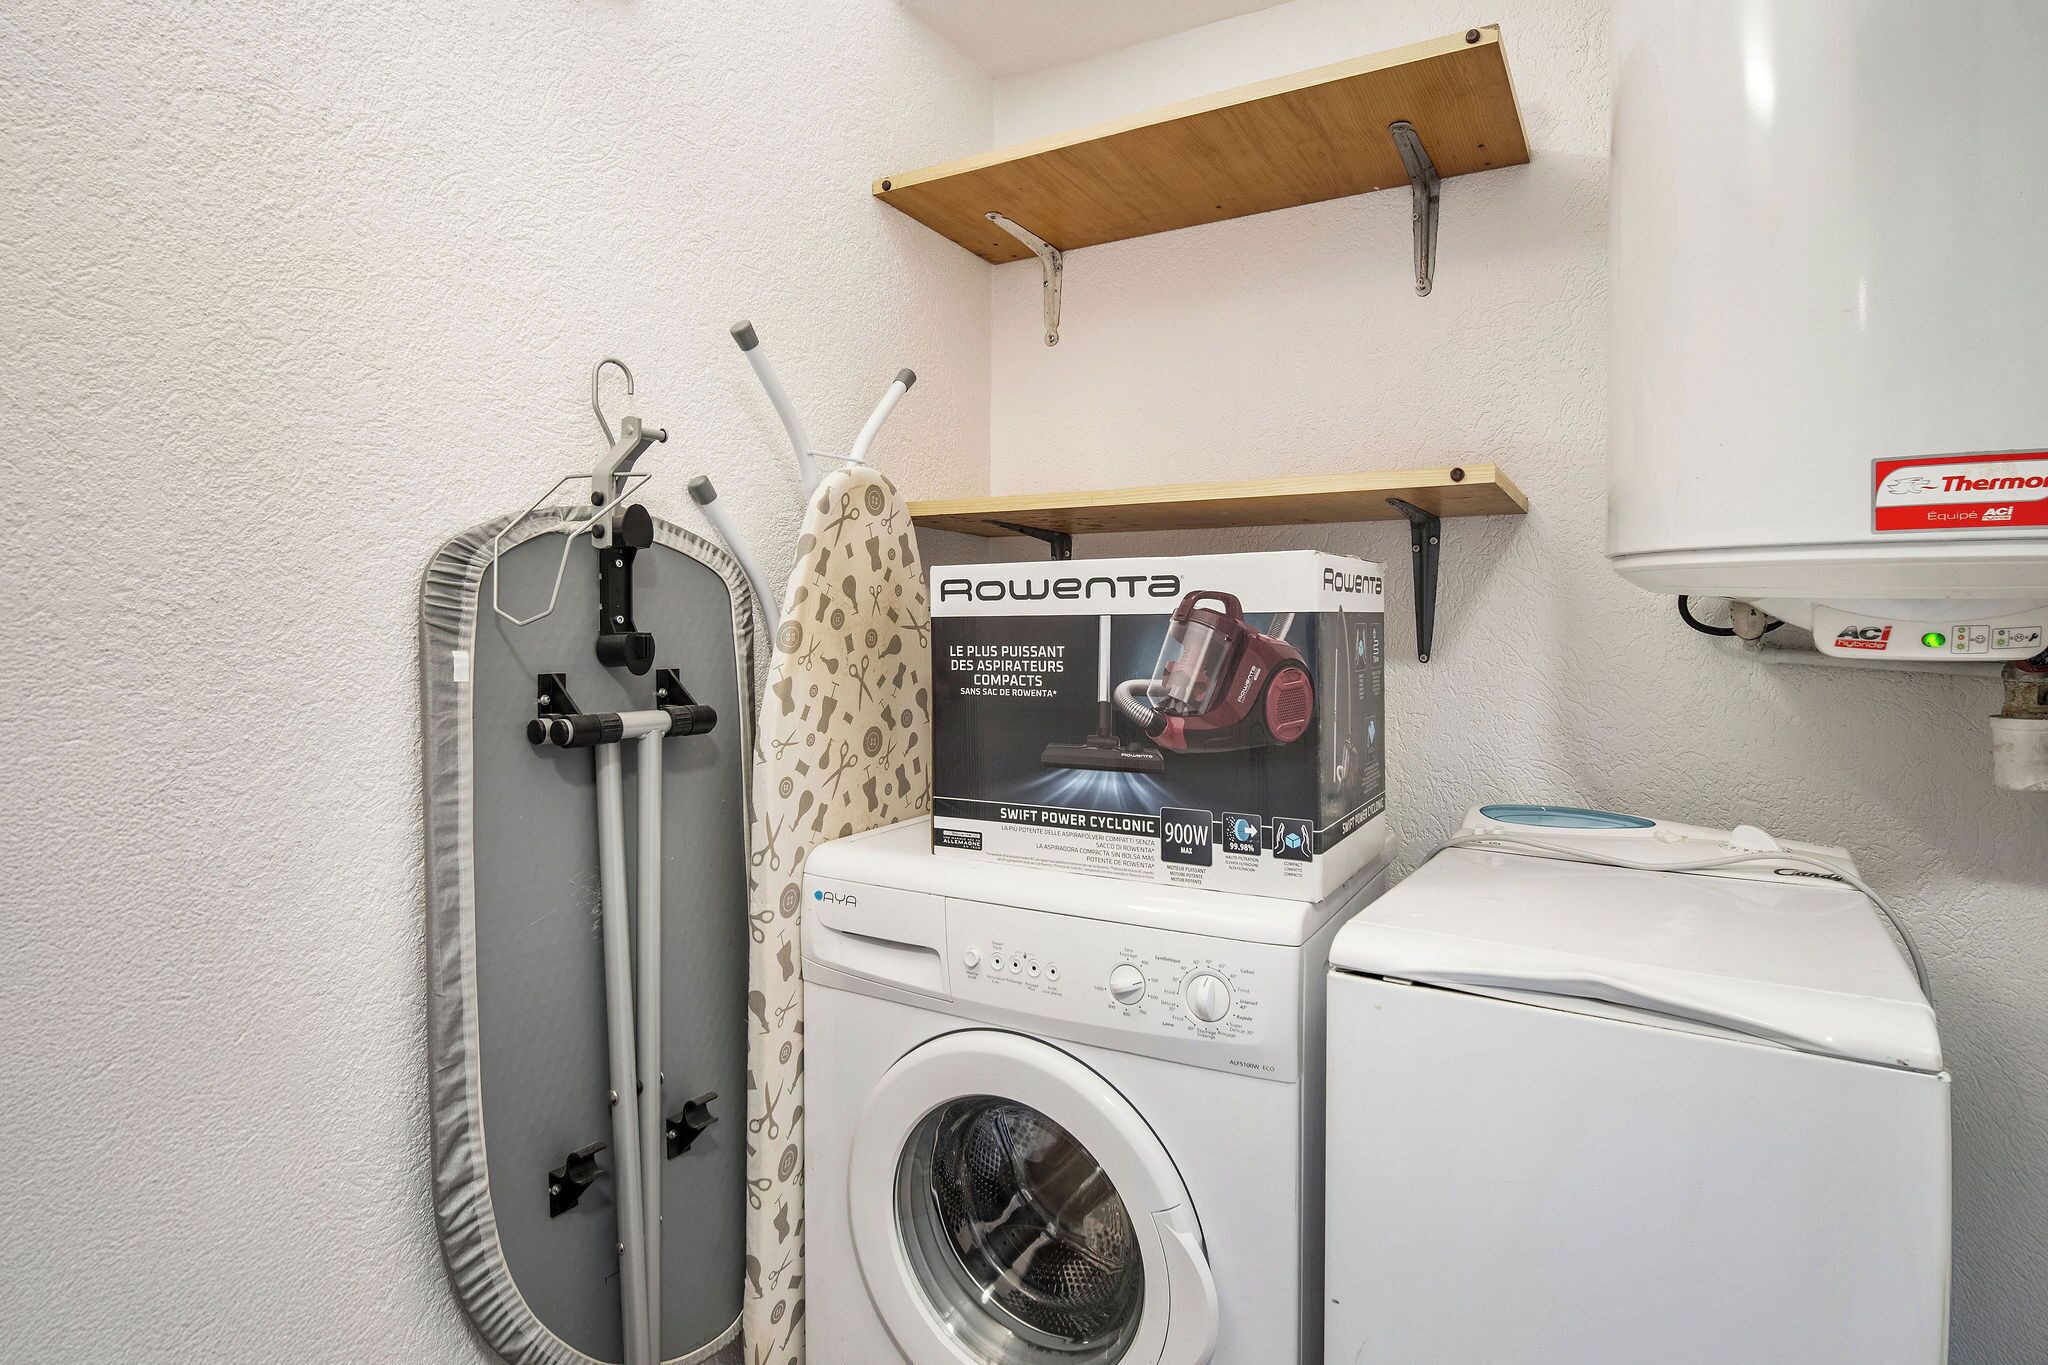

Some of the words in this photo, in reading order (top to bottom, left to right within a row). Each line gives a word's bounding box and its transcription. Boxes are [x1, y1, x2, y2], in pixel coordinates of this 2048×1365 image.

[1927, 510, 1978, 521] Équipé
[1837, 639, 1885, 649] hybride
[950, 645, 964, 657] LE
[967, 645, 998, 658] PLUS
[1001, 645, 1065, 658] PUISSANT
[951, 660, 974, 671] DES
[976, 660, 1064, 673] ASPIRATEURS
[973, 674, 1043, 687] COMPACTS
[960, 687, 981, 696] SANS
[982, 688, 998, 697] SAC
[999, 688, 1011, 697] DE
[1000, 807, 1038, 822] SWIFT
[1041, 811, 1087, 827] POWER
[1090, 815, 1155, 833] CYCLONIC
[1342, 815, 1355, 835] SWIFT
[1355, 808, 1368, 826] POWER
[1018, 826, 1043, 835] POTENTE
[1044, 829, 1061, 837] DELLE
[1062, 830, 1105, 841] ASPIRAPOLVERI
[1105, 835, 1135, 844] COMPATTI
[1135, 838, 1155, 846] SENZA
[1164, 822, 1209, 847] 900W
[943, 839, 981, 847] ALLEMAGNE
[1229, 842, 1255, 852] 99.98%
[1044, 844, 1079, 853] ASPIRADORA
[1079, 847, 1110, 856] COMPACTA
[1122, 852, 1141, 860] BOLSA
[1180, 847, 1193, 855] MAX
[1087, 856, 1113, 865] POTENTE
[1185, 866, 1206, 874] PUISSANT
[1773, 868, 1844, 882] Candy
[823, 891, 857, 907] AYA
